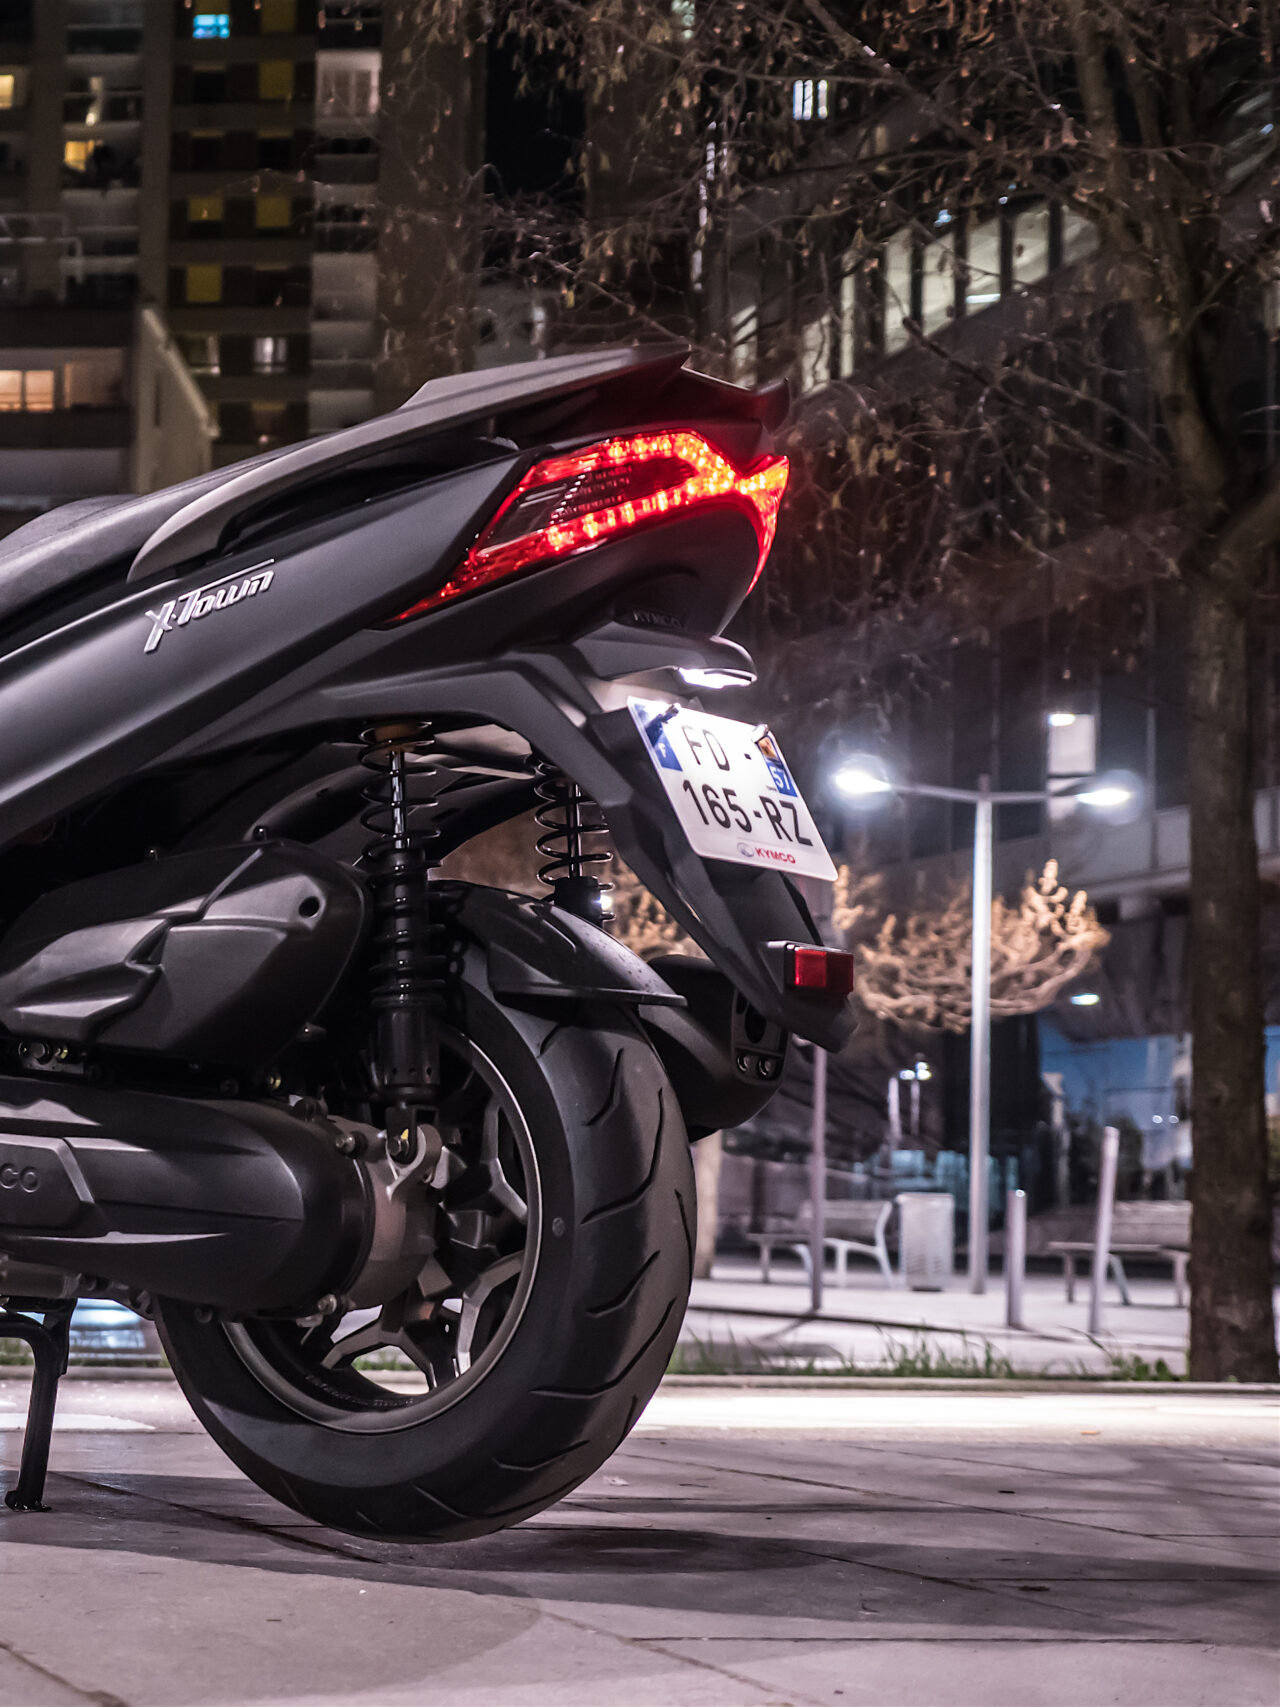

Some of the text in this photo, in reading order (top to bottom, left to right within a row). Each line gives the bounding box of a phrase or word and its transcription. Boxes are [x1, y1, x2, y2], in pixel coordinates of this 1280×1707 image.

[769, 766, 791, 790] 57
[682, 780, 813, 847] 165-RZ
[755, 848, 796, 864] KYMCO
